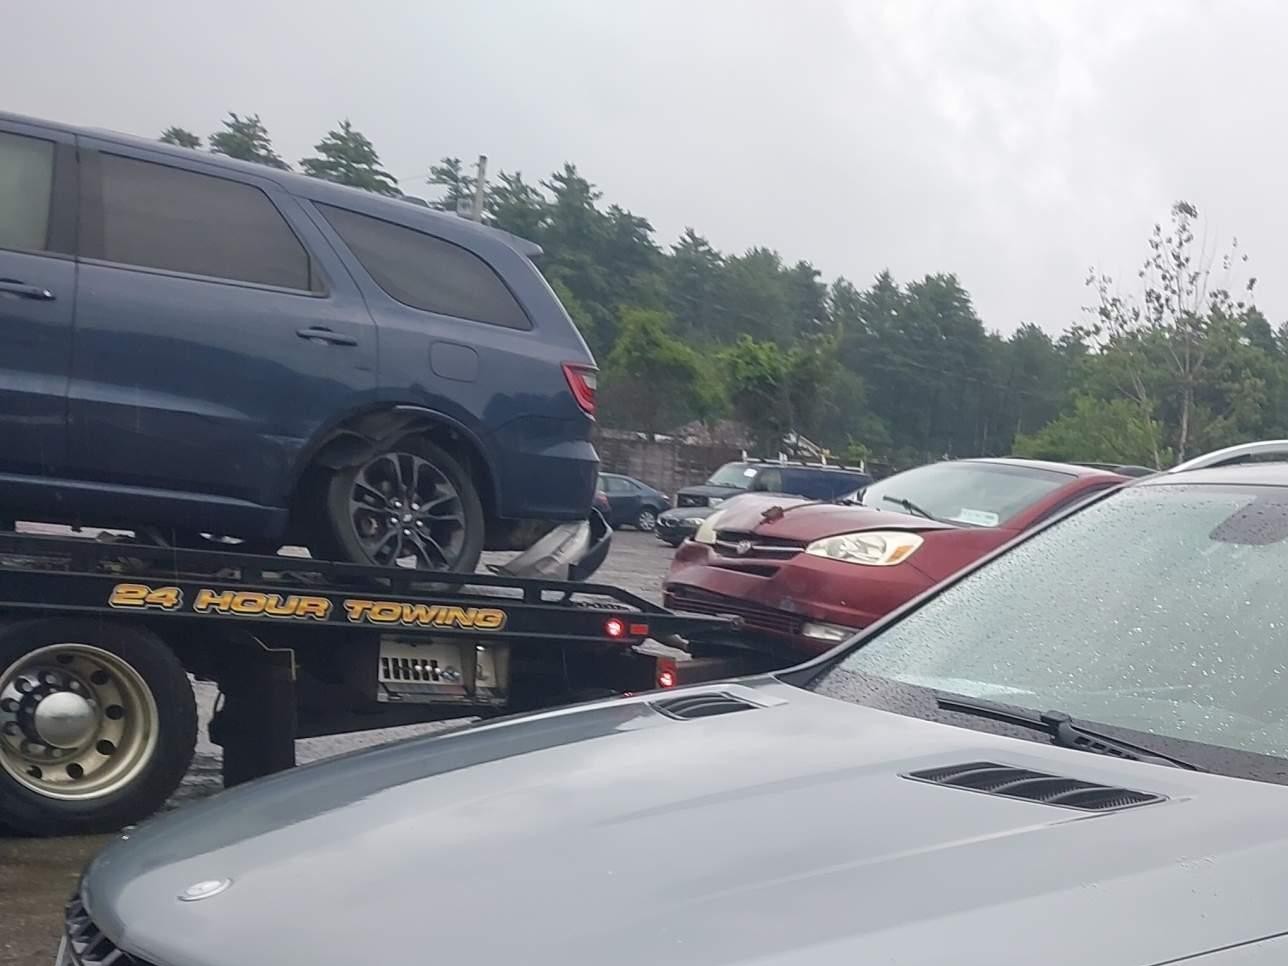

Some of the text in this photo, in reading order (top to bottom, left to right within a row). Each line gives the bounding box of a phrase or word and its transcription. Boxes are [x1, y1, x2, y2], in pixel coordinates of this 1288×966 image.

[110, 584, 507, 632] 24 HOUR TOWING
